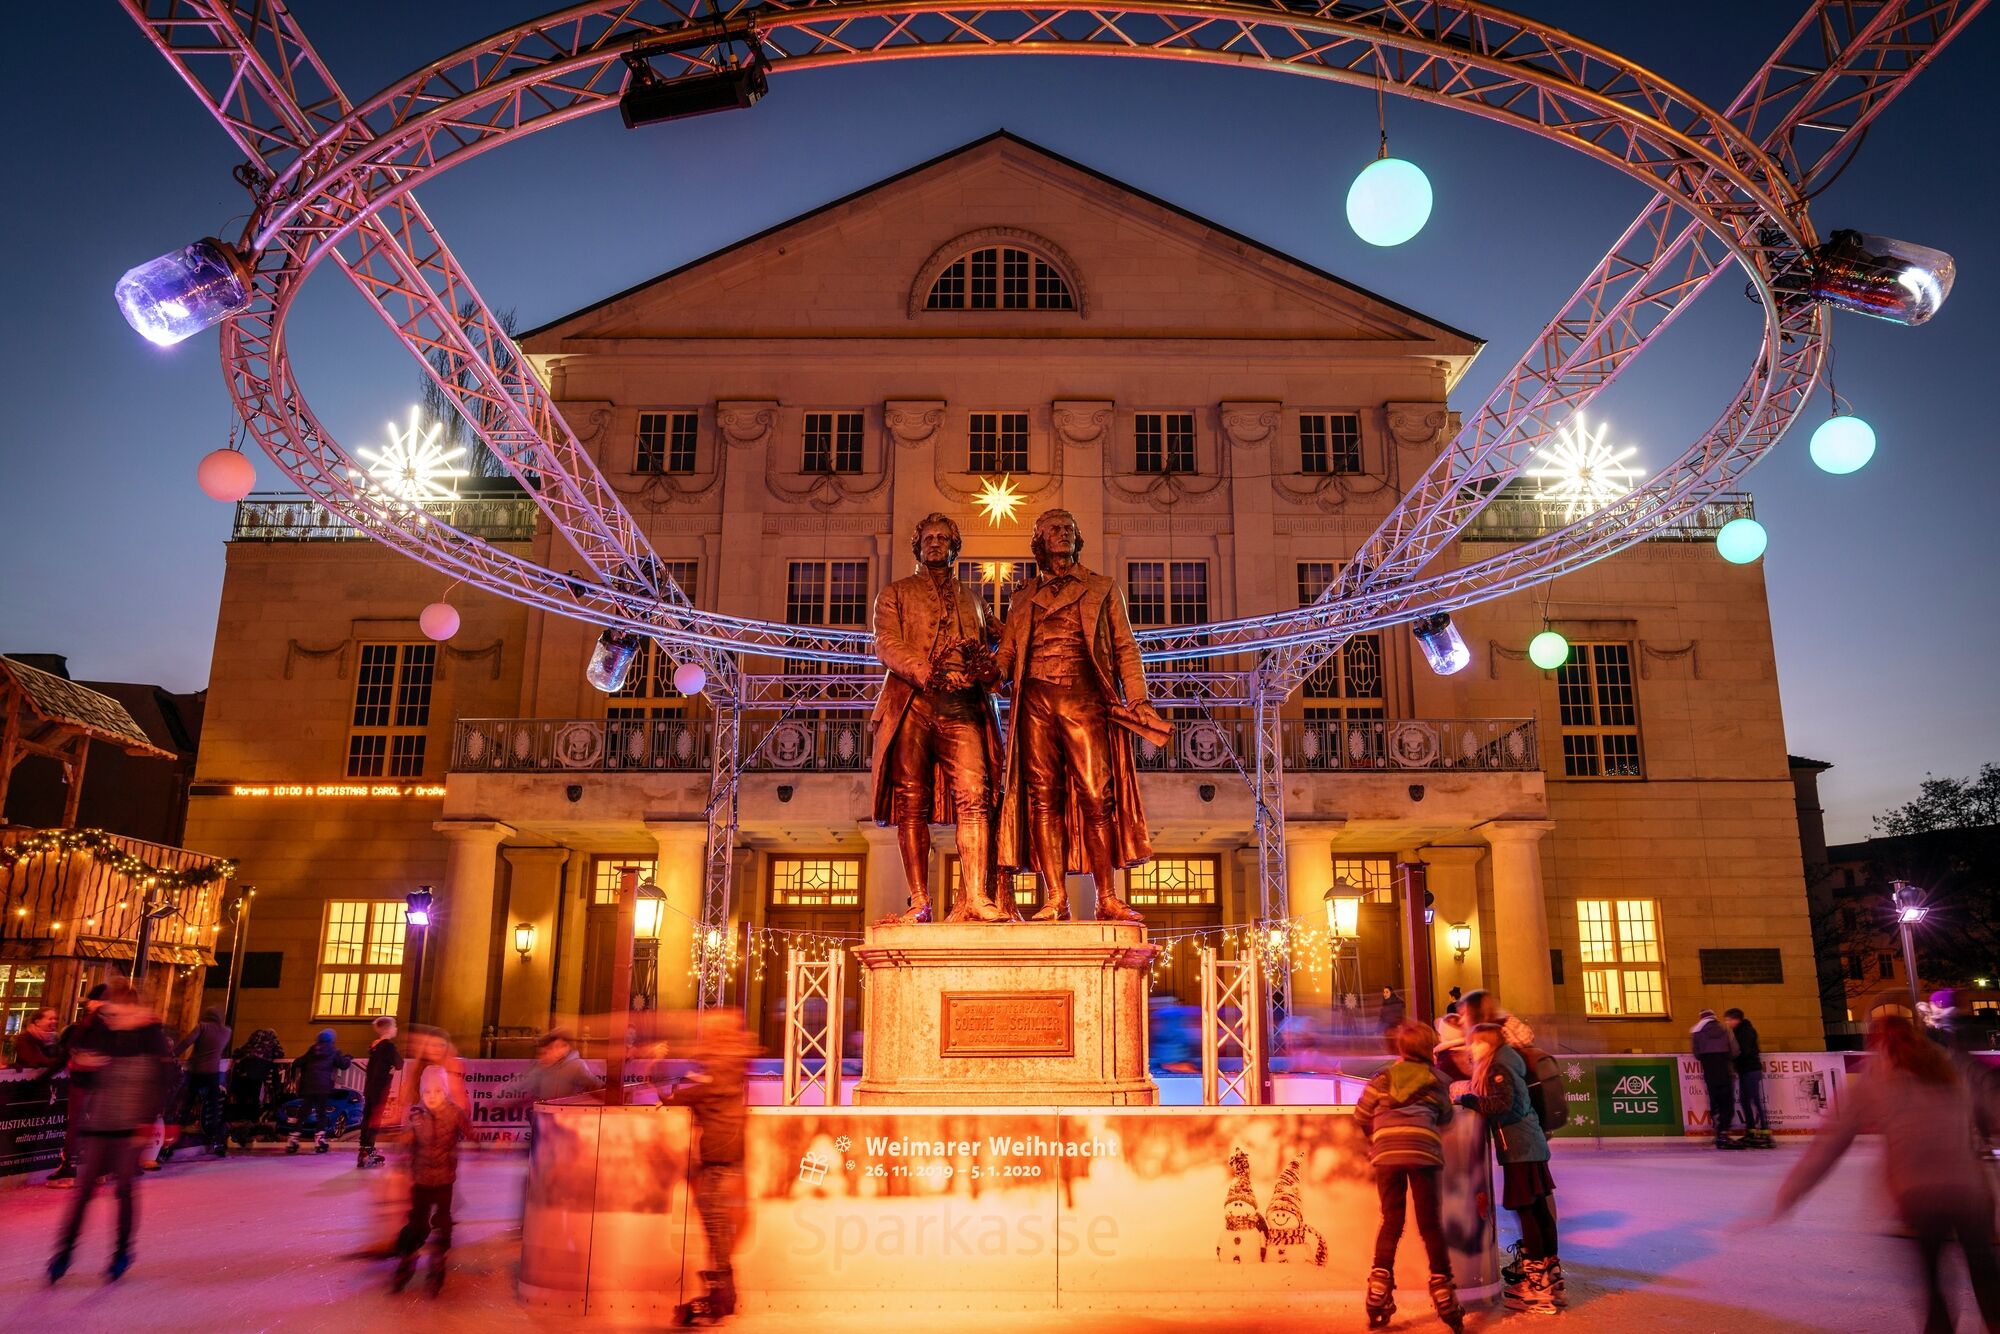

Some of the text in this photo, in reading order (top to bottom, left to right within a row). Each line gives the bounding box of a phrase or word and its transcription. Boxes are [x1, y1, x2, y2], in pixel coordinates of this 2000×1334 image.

[234, 786, 269, 796] Morgen
[273, 786, 302, 796] 10:00
[305, 787, 313, 796] A
[316, 786, 368, 796] CHRISTMAS
[371, 786, 400, 796] CAROL
[954, 1017, 995, 1031] GOETHE
[1009, 1017, 1060, 1031] SCHILLER
[1770, 1061, 1789, 1073] SIE
[1792, 1061, 1812, 1073] EIN
[1612, 1075, 1657, 1095] AOK
[473, 1089, 493, 1099] ins
[1613, 1101, 1659, 1114] PLUS
[46, 1114, 69, 1126] ALM-
[865, 1136, 1117, 1157] Weimarer Weihnacht
[792, 1203, 1120, 1271] Sparkasse
